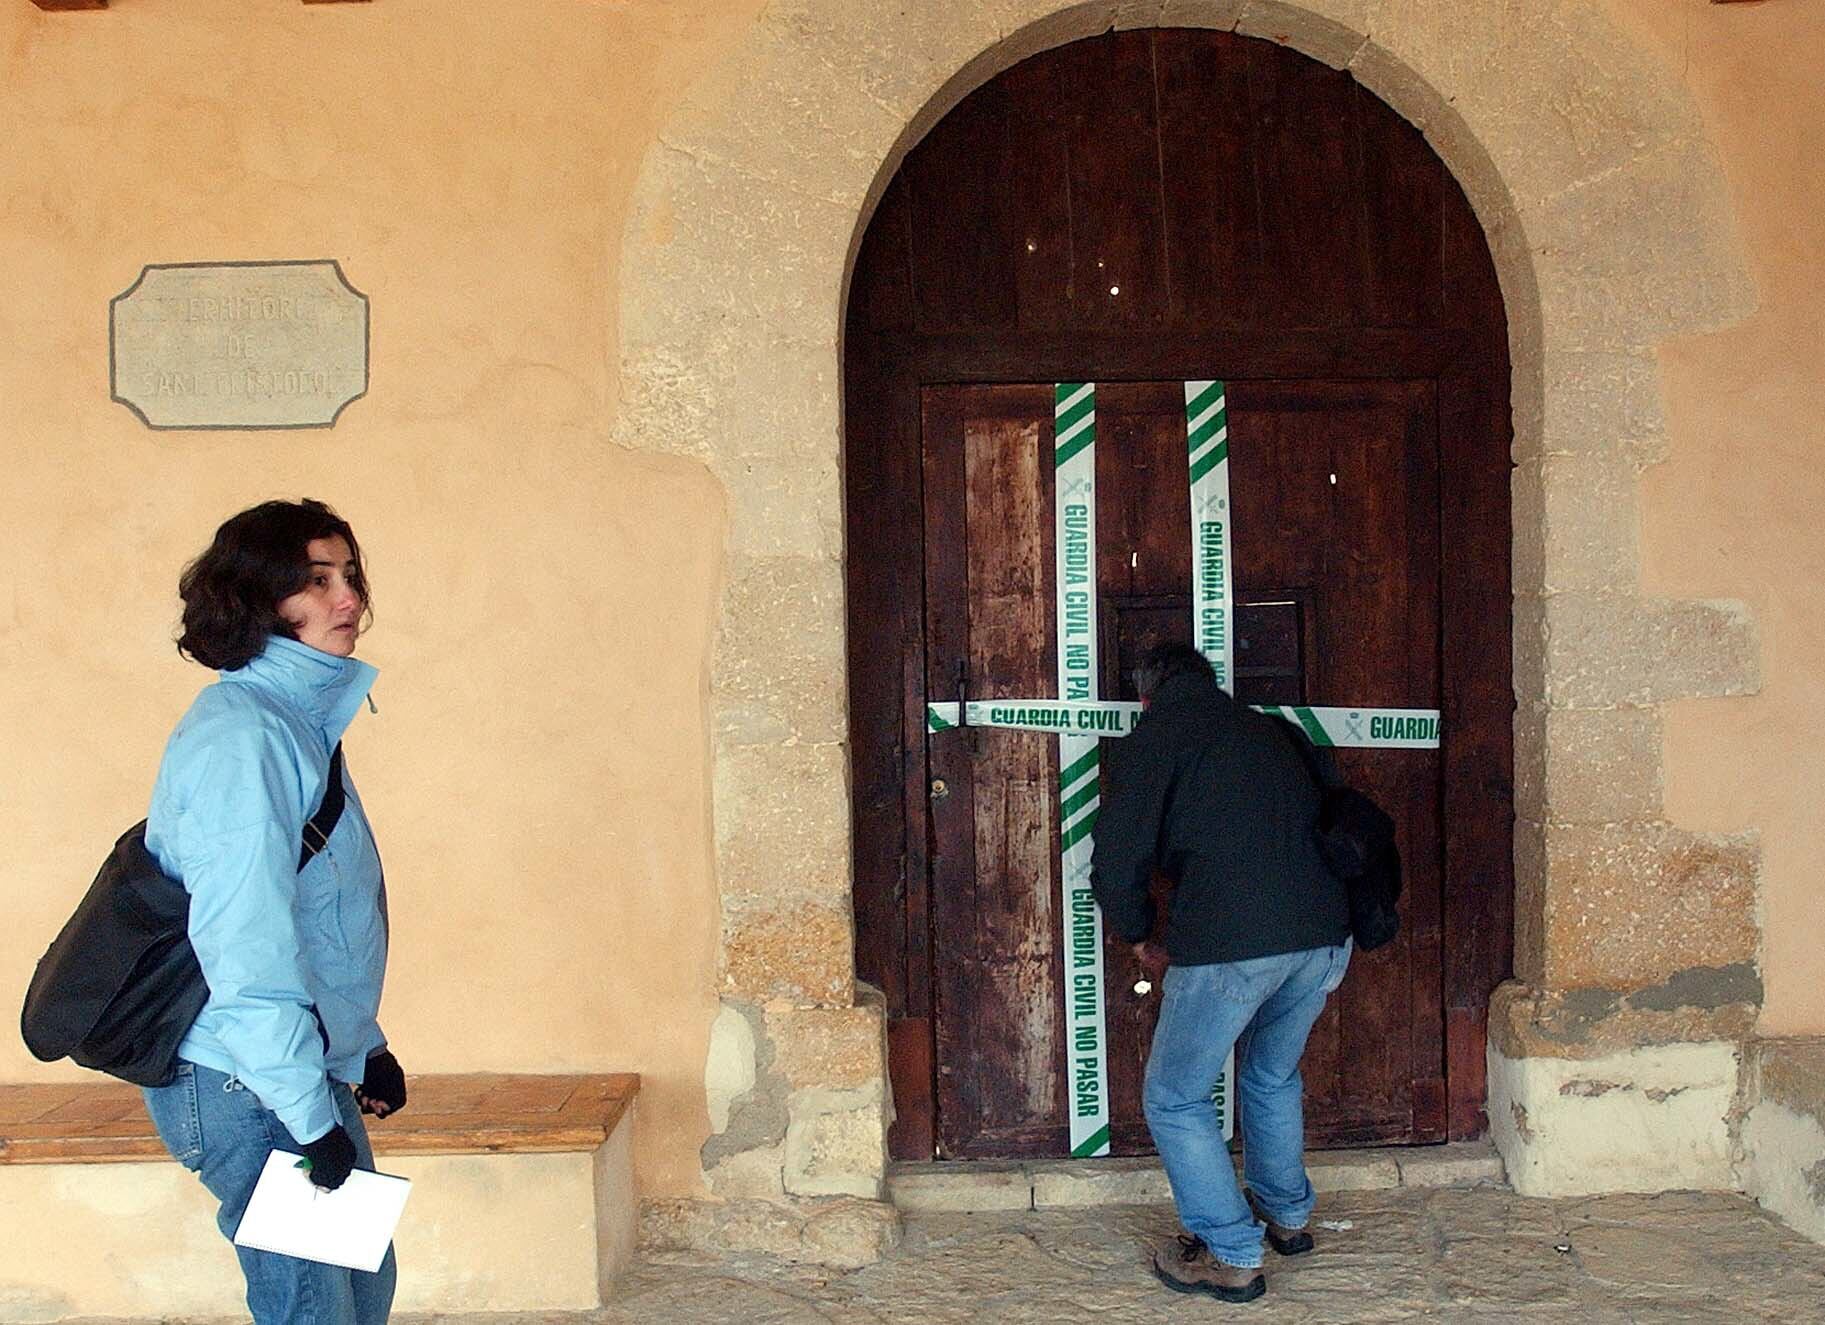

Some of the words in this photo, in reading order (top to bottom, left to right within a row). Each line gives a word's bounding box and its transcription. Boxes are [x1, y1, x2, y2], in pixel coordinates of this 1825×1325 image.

[1064, 504, 1088, 585] GUARDIA
[1200, 521, 1225, 602] GUARDIA
[1065, 591, 1089, 638] CIVIL
[1201, 608, 1225, 657] CIVIL
[1066, 644, 1090, 670] NO
[991, 707, 1071, 728] GUARDIA
[1077, 709, 1124, 731] CIVIL
[1071, 888, 1096, 969] GUARDIA
[1073, 974, 1097, 1020] CIVIL
[1075, 1026, 1098, 1052] NO
[1076, 1057, 1100, 1117] PASAR
